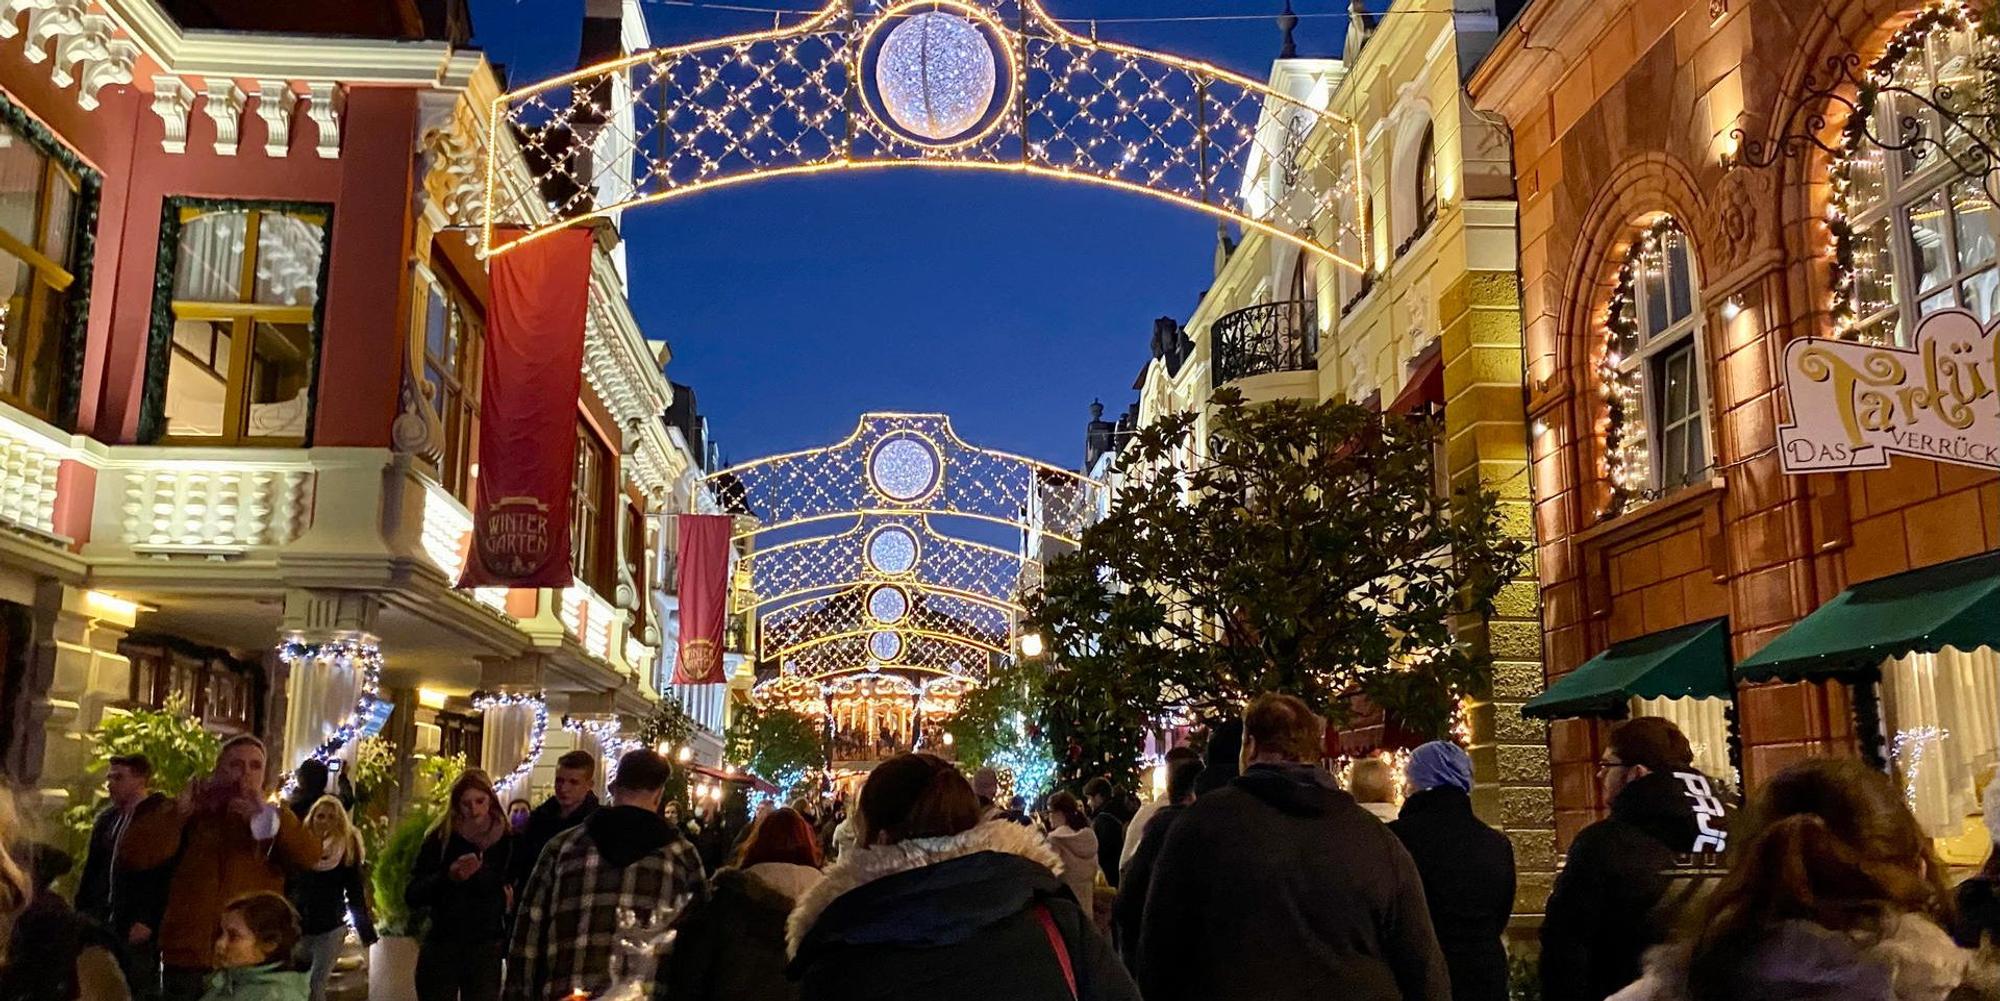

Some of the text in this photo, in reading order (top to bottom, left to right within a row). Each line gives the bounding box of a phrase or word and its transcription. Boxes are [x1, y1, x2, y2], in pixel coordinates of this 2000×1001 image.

[1798, 331, 2000, 452] Tartü
[488, 512, 548, 535] WINTER
[485, 533, 548, 554] GARTEN
